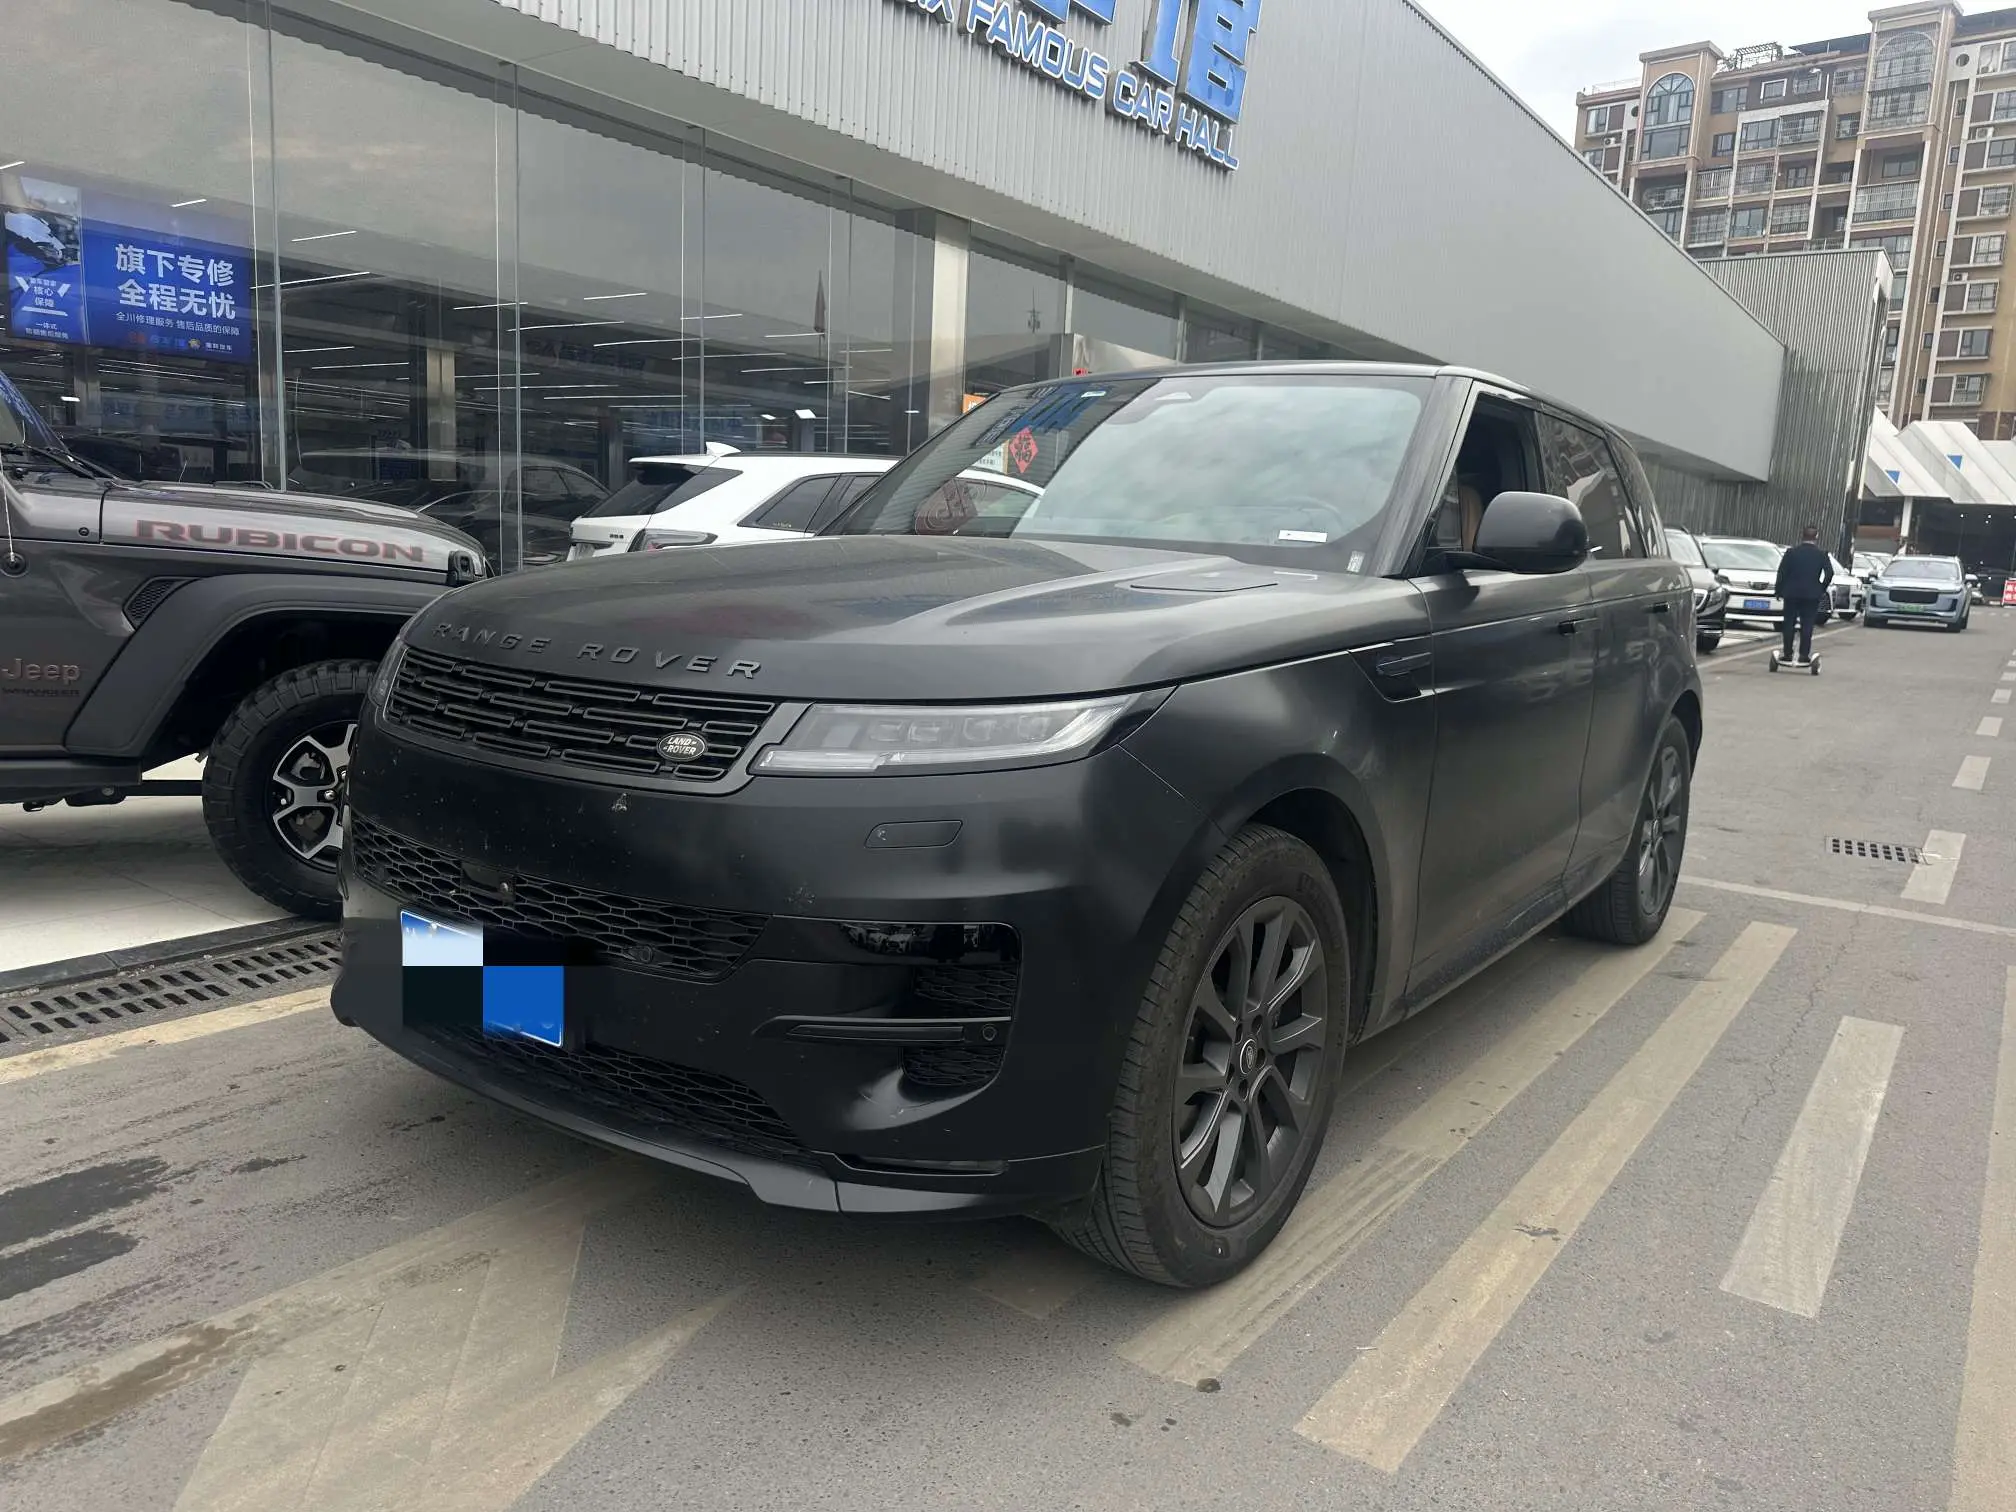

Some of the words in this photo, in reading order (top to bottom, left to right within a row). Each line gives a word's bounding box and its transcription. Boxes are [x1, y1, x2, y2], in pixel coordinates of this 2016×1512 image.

[966, 0, 1109, 101] FAMOUS
[1113, 69, 1175, 134] CAR
[1175, 102, 1240, 171] HALL
[115, 243, 235, 287] 旗下专修
[117, 278, 236, 320] 全程无忧
[135, 519, 424, 563] RUBICON
[1, 658, 81, 686] Jeep
[431, 623, 551, 654] RANGE
[576, 643, 762, 679] ROVER
[667, 736, 692, 746] LAND
[667, 744, 697, 756] ROVER
